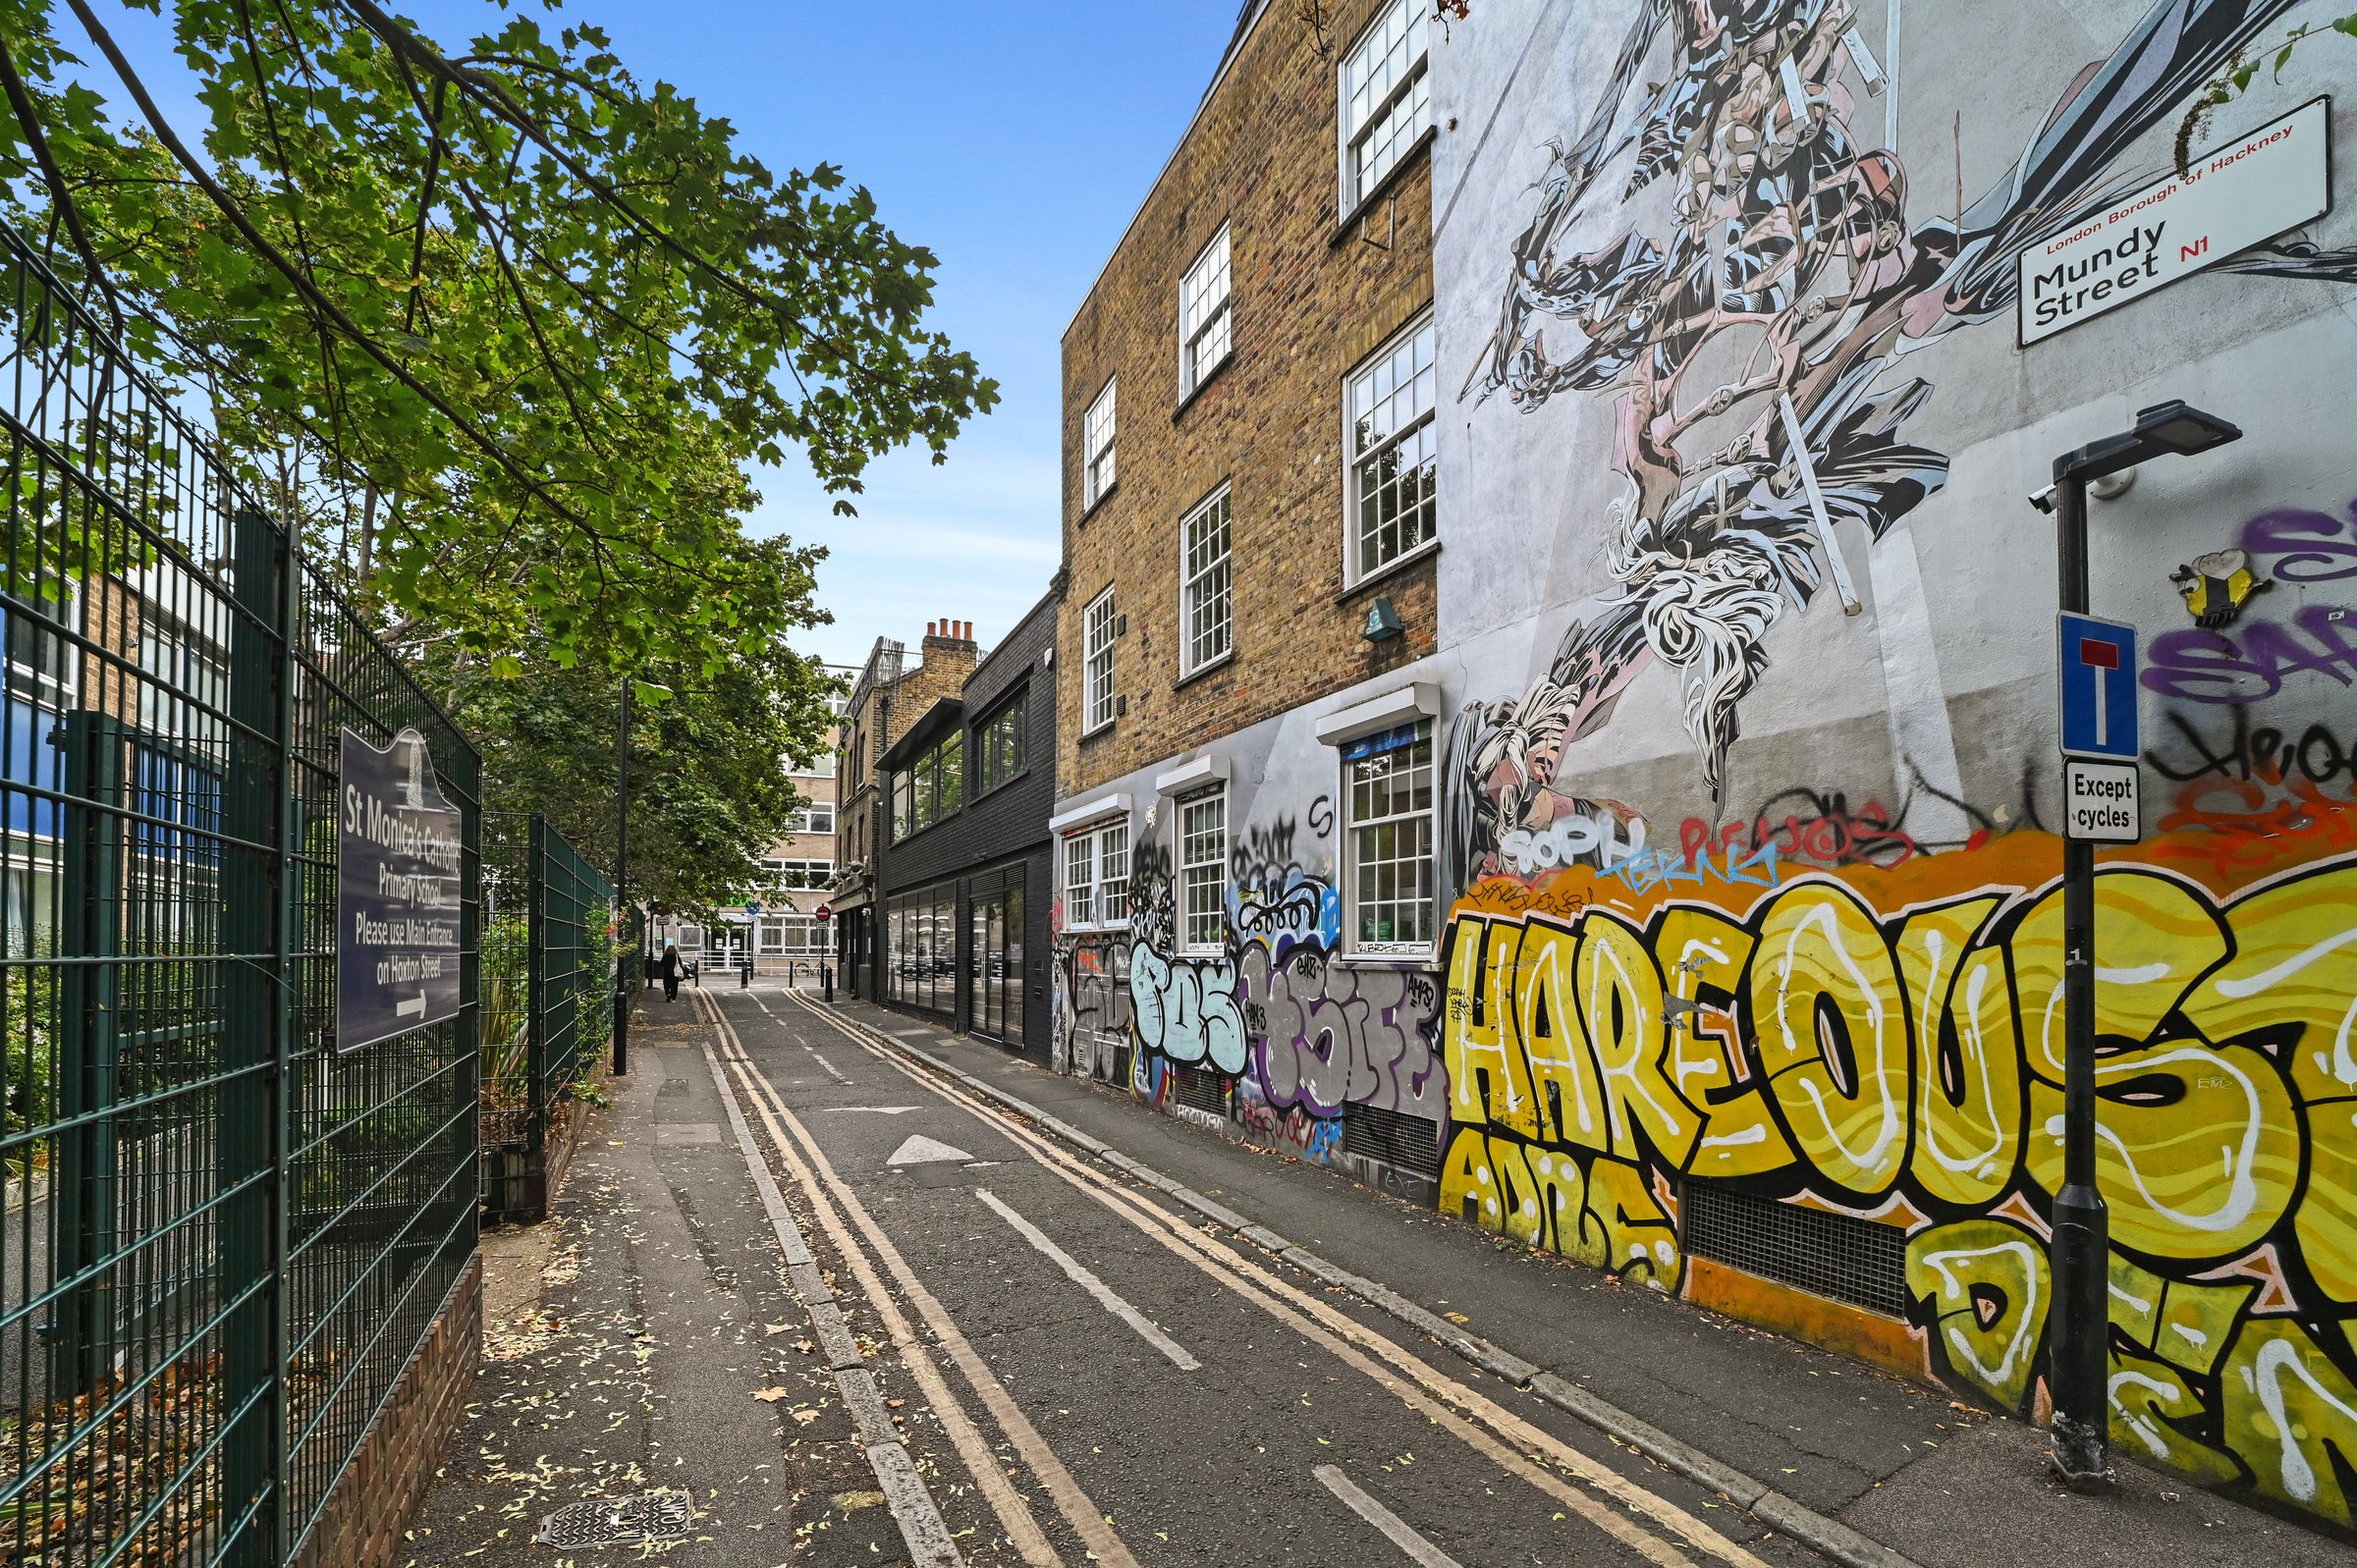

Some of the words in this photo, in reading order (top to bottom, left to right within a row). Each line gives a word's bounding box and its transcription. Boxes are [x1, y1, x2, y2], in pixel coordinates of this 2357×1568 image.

[2047, 222, 2102, 255] London
[2108, 184, 2177, 224] Borough
[2185, 168, 2203, 187] of
[2210, 124, 2294, 174] Hackney
[2034, 219, 2166, 300] Mundy
[2035, 250, 2160, 327] Street
[2180, 235, 2210, 262] N1
[2074, 773, 2132, 801] Except
[346, 784, 363, 837] St
[366, 793, 422, 860] Monica's
[424, 826, 461, 874] Catholic
[2077, 804, 2130, 830] cycles
[379, 862, 415, 909] Primary
[417, 874, 441, 907] School
[356, 911, 388, 946] Please
[390, 923, 405, 945] use
[407, 918, 425, 946] Main
[426, 921, 454, 946] Entrance
[377, 961, 389, 986] on
[391, 954, 420, 984] Hoxton
[421, 953, 441, 980] Street
